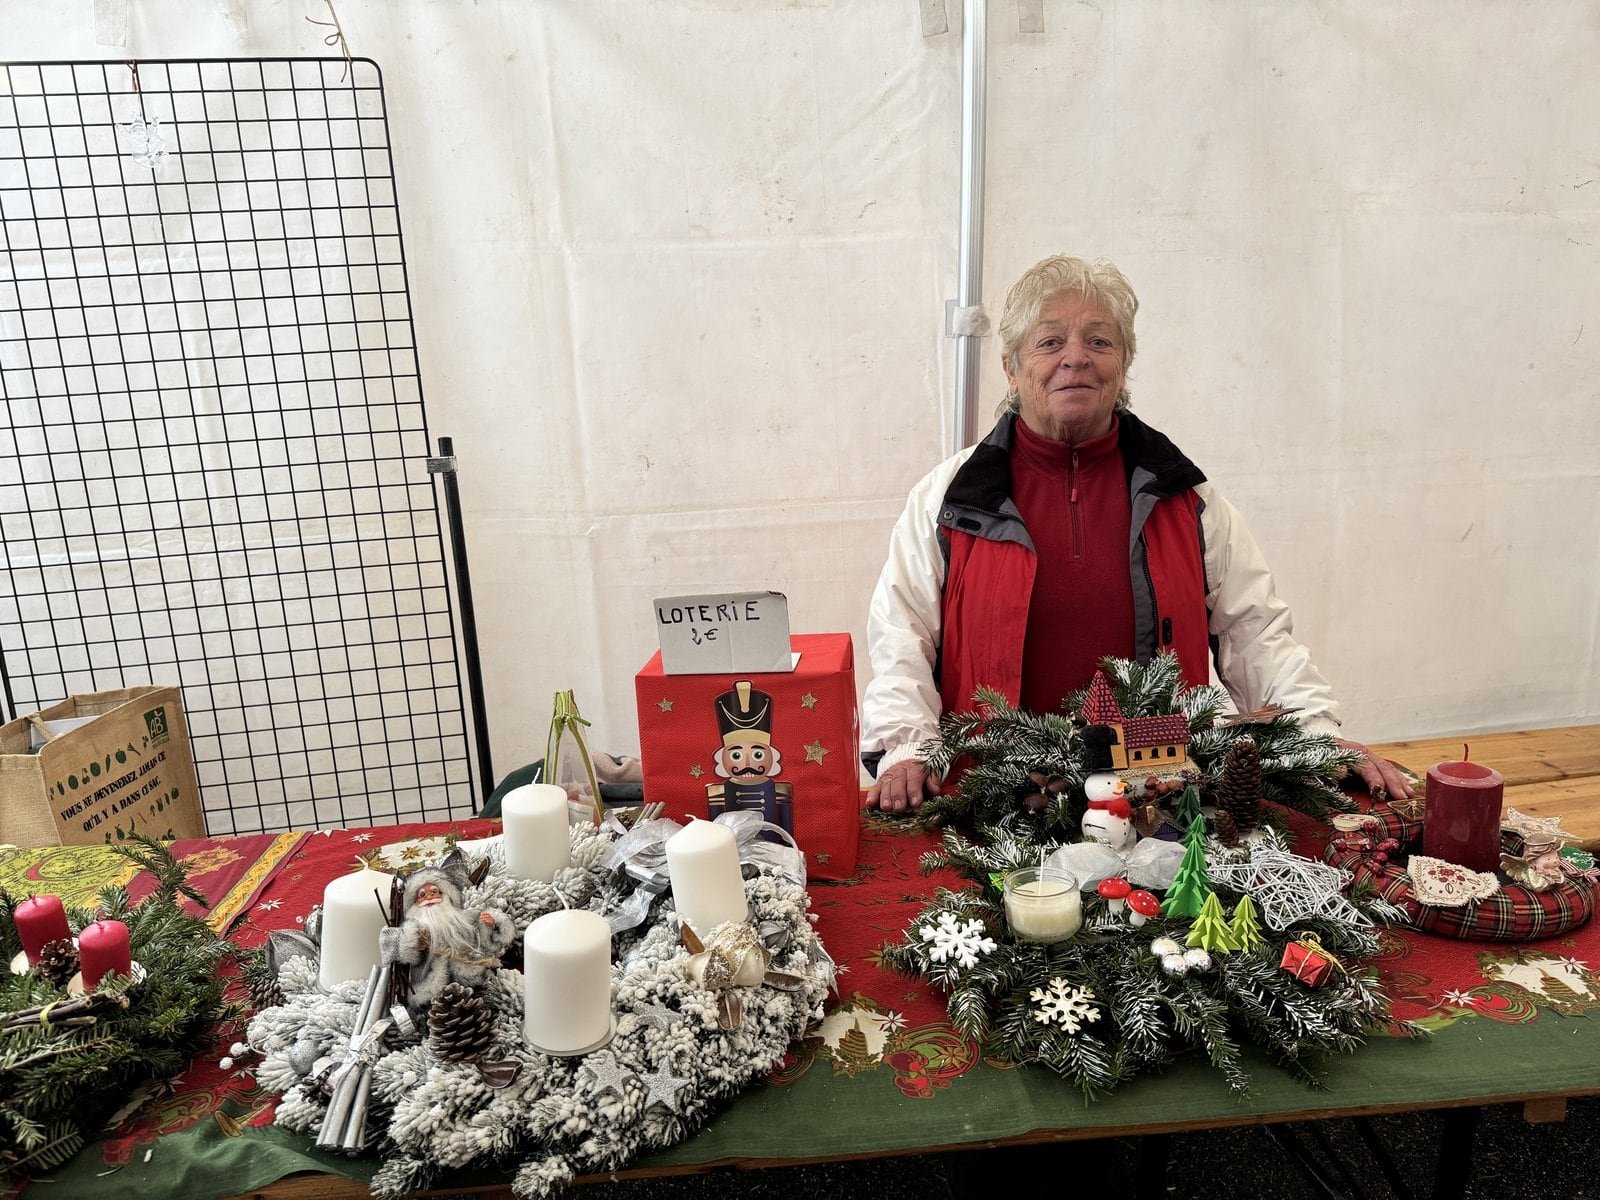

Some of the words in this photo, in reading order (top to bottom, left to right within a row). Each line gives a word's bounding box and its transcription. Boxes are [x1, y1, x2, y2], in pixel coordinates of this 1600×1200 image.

[150, 717, 164, 738] AB
[60, 802, 82, 821] VOUS
[82, 795, 93, 809] NE
[94, 771, 138, 802] DEVINEREZ
[139, 756, 158, 777] JAMAIS
[157, 751, 166, 762] CE
[83, 814, 102, 832] QU'IL
[101, 808, 109, 819] Y
[111, 804, 119, 815] A
[119, 791, 141, 810] DANS
[141, 785, 149, 796] CE
